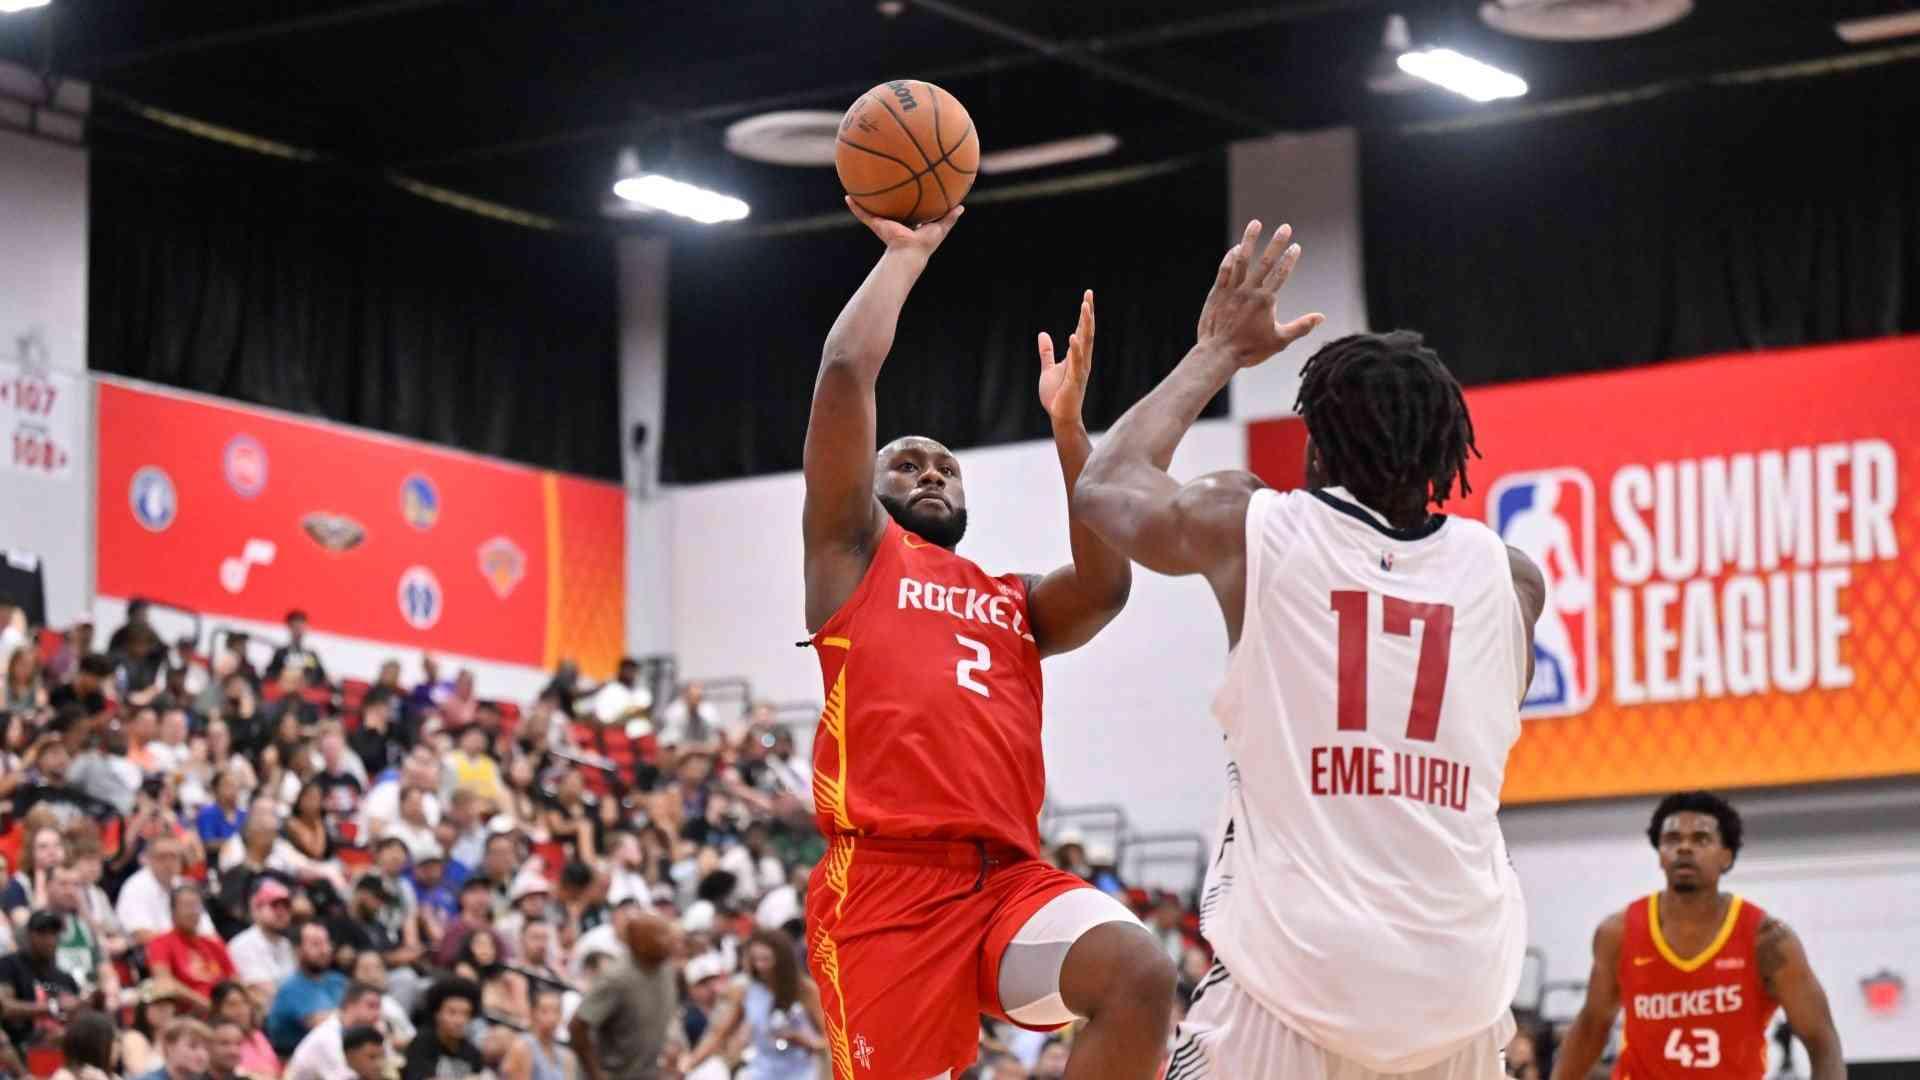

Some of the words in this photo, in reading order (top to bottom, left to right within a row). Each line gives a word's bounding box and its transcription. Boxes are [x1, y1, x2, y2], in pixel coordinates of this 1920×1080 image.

[1610, 438, 1899, 584] SUMMER
[955, 633, 992, 698] 2
[1330, 589, 1455, 743] 17
[1610, 567, 1855, 707] LEAGUE
[1310, 745, 1471, 813] EMEJURU
[1633, 984, 1743, 1020] ROCKETS
[1663, 1027, 1721, 1069] 43
